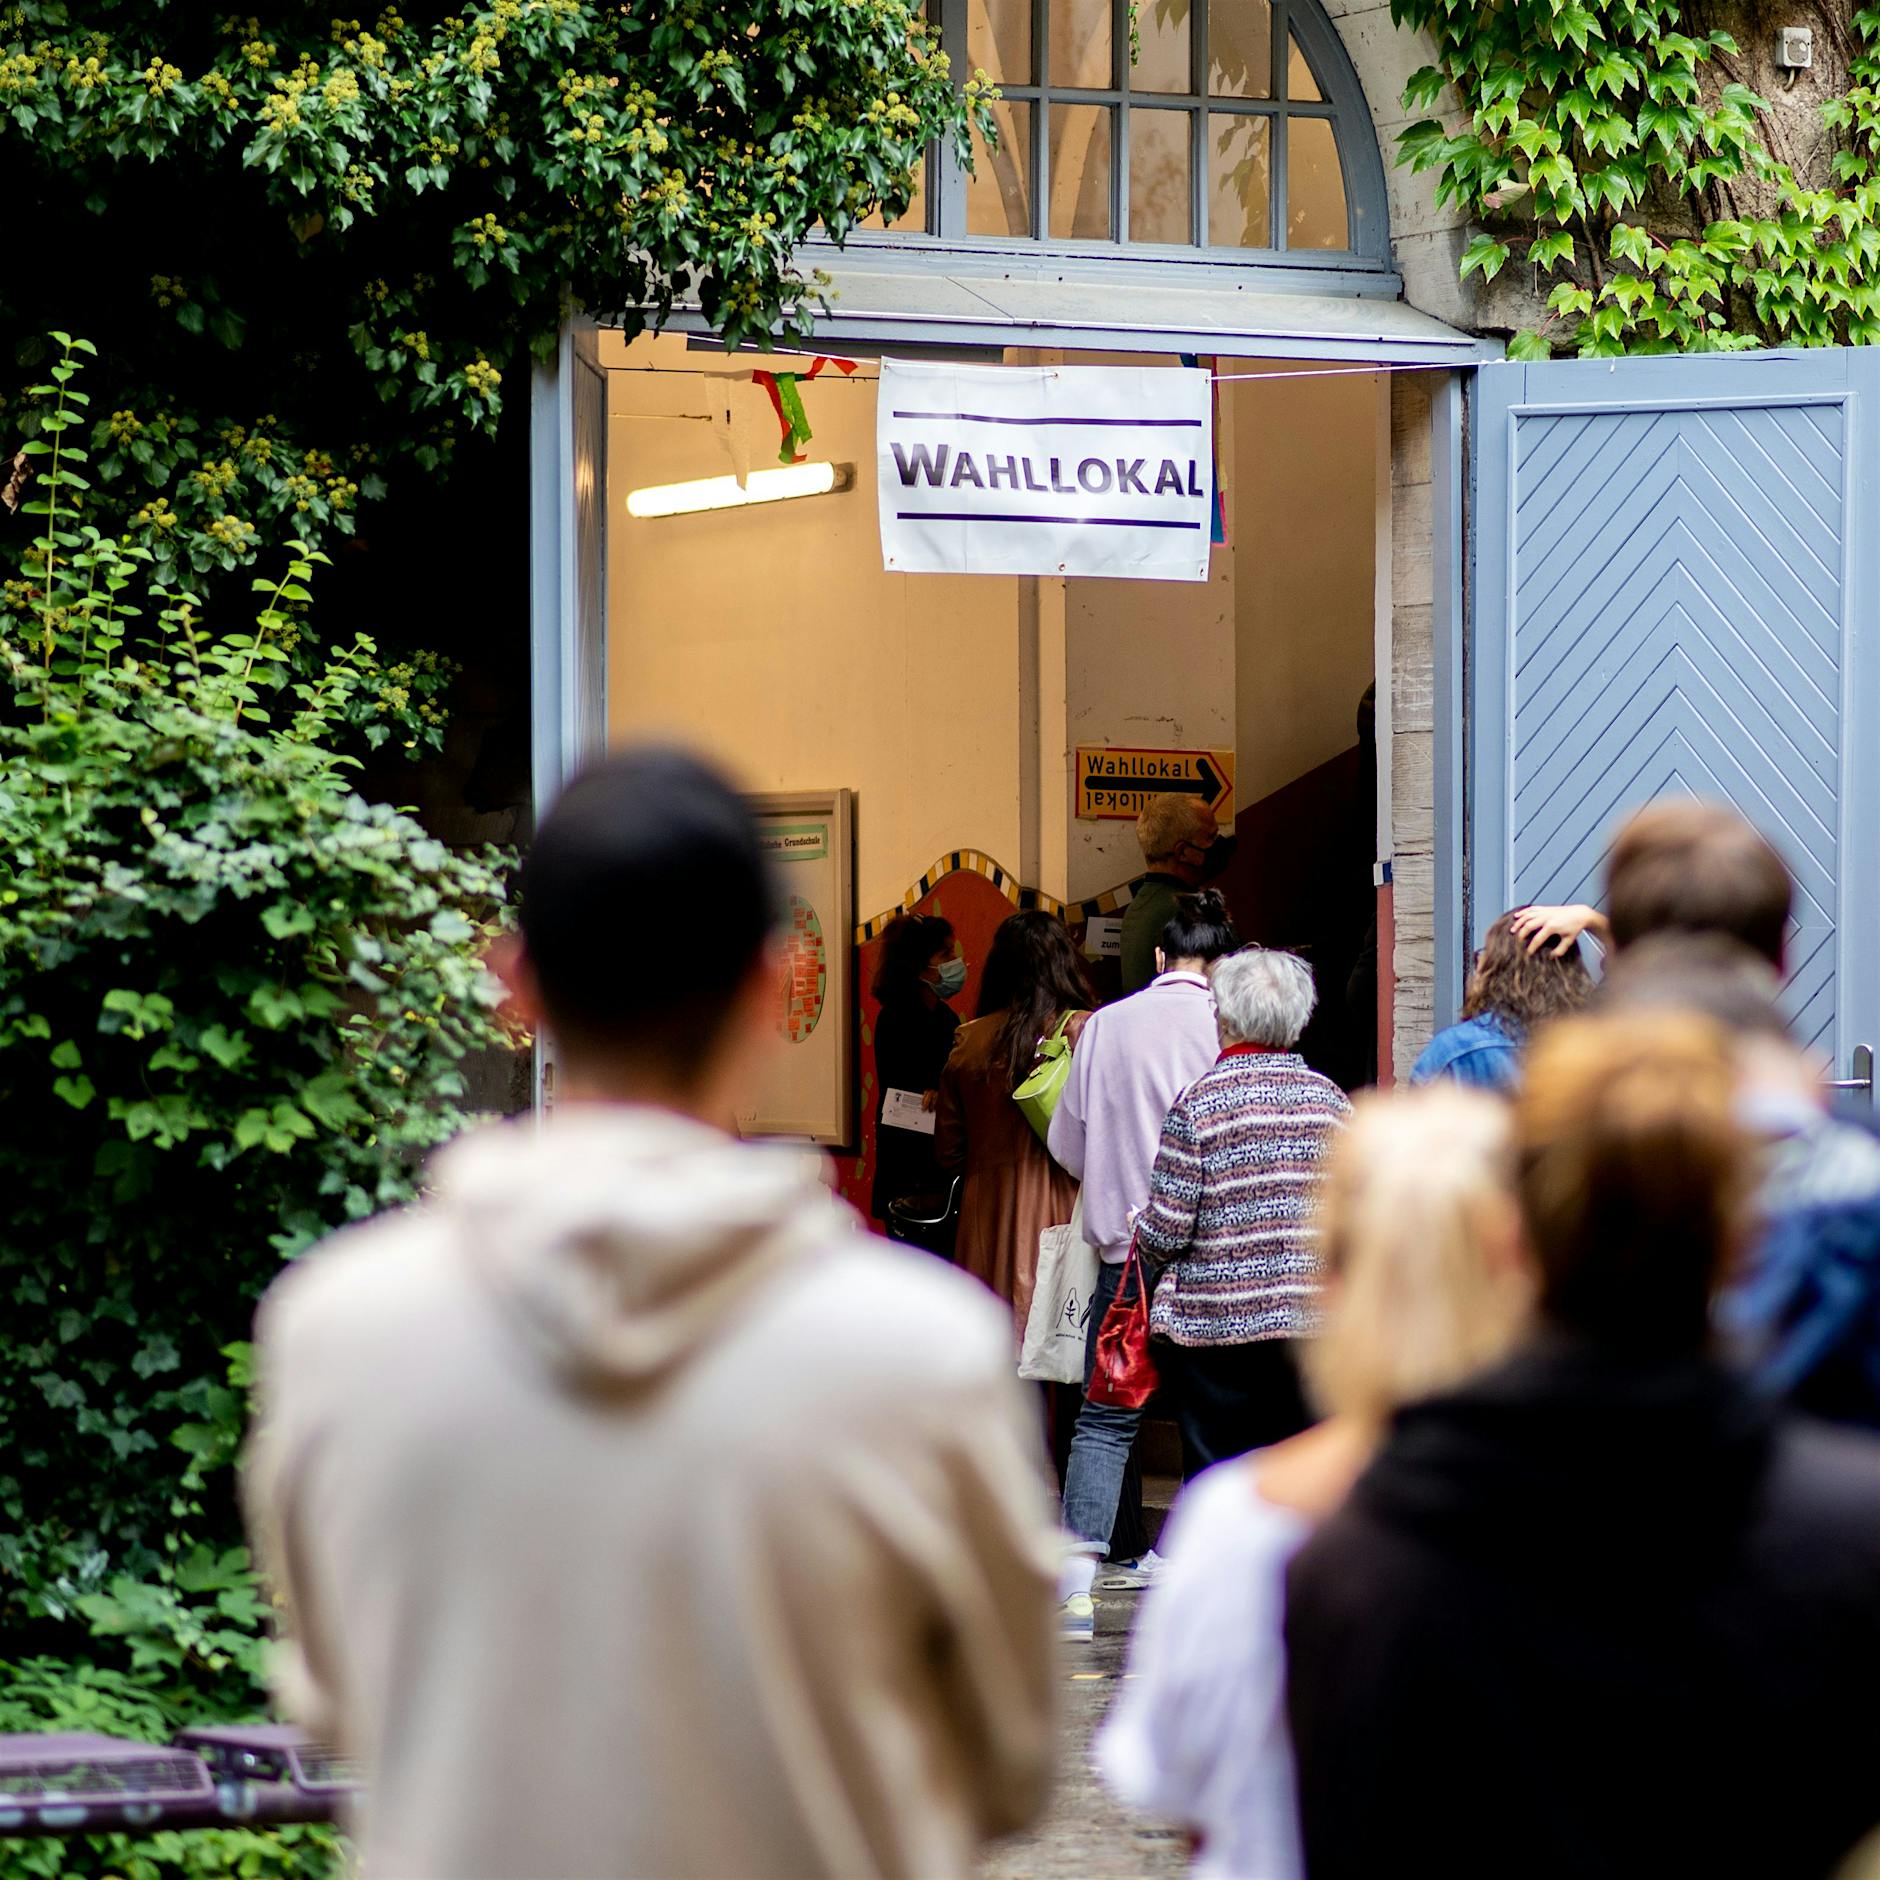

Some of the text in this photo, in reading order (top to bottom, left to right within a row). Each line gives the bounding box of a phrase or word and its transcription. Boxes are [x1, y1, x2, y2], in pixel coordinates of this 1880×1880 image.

[890, 442, 1204, 498] WAHLLOKAL
[1087, 755, 1190, 777] Wahllokal
[1086, 791, 1157, 812] llokal
